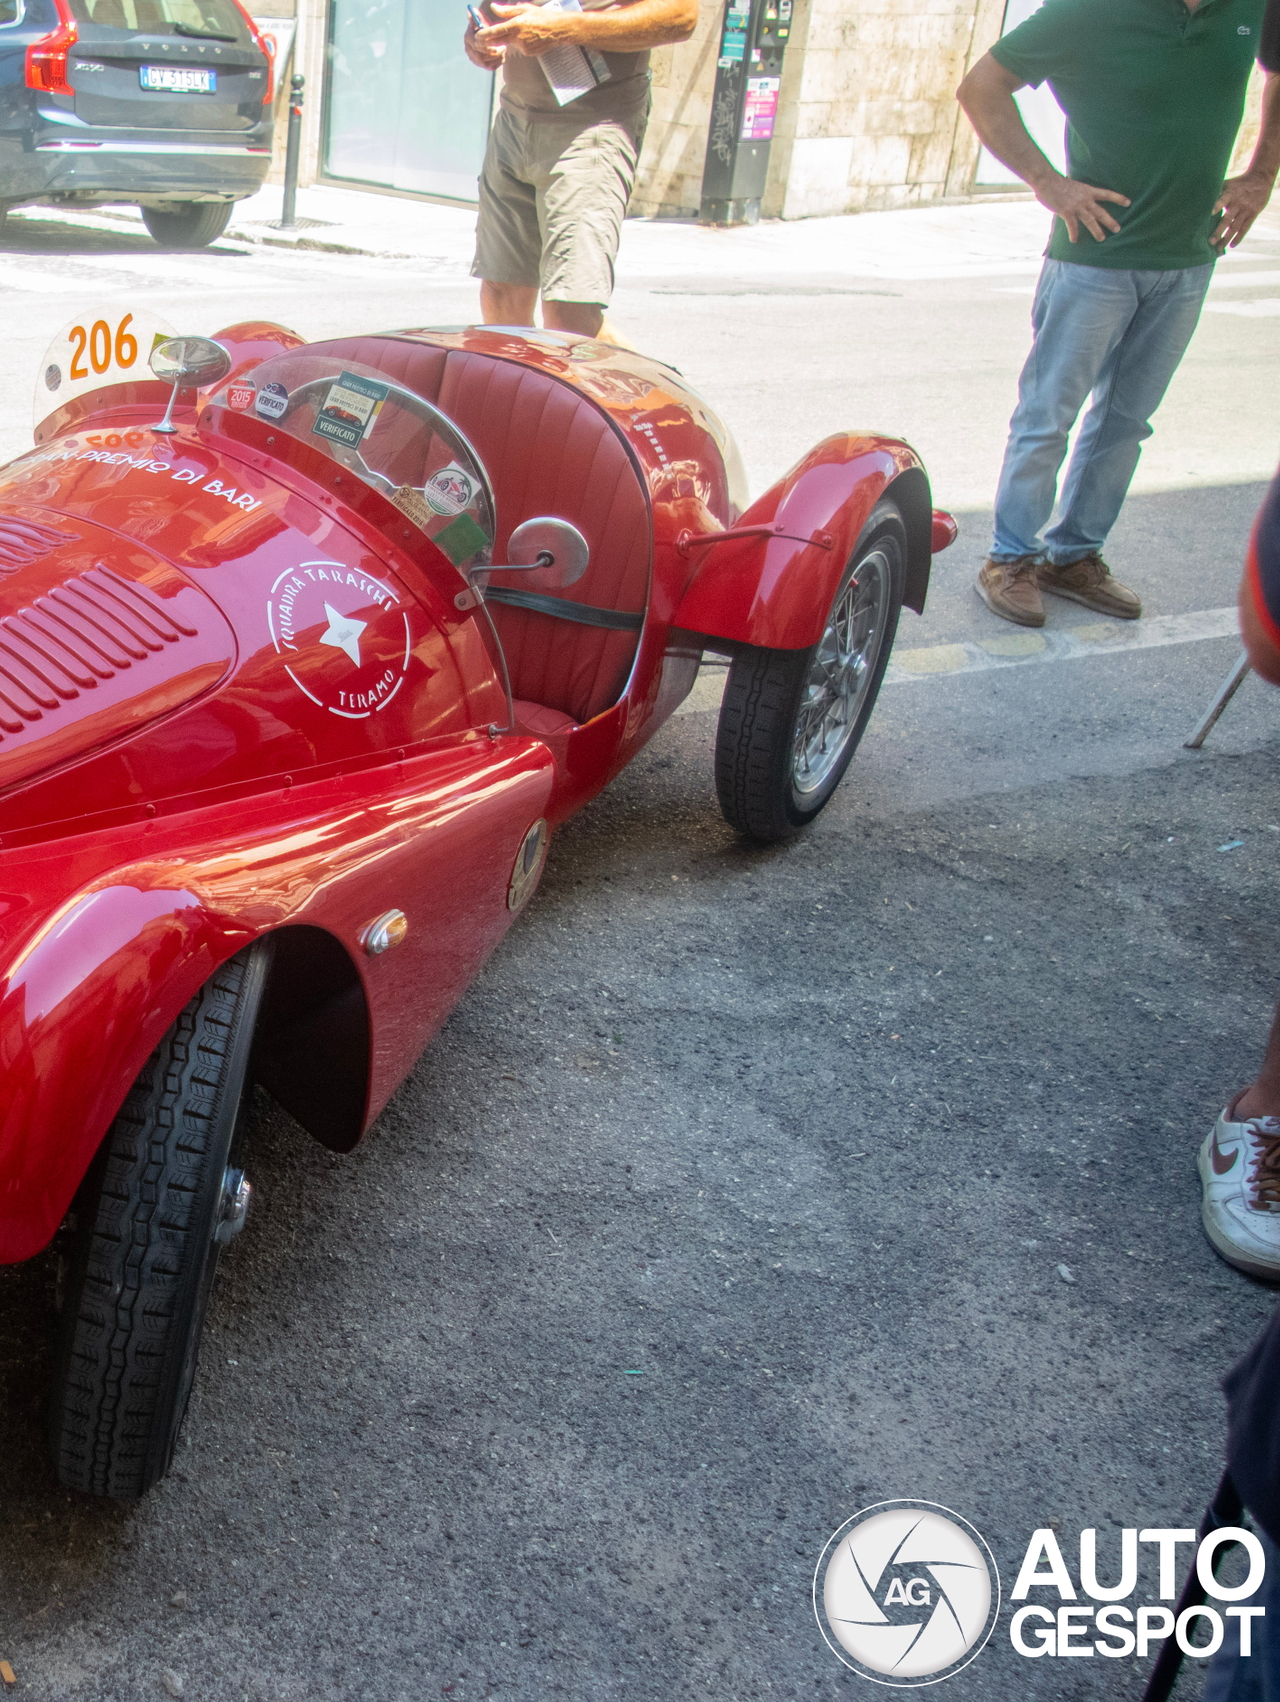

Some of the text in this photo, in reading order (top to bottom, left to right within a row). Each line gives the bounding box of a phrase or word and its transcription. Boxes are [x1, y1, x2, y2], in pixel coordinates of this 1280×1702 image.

[142, 43, 222, 54] VOLVO
[150, 68, 208, 88] GV 315LK
[68, 312, 138, 381] 206
[231, 390, 251, 402] 2015
[259, 395, 285, 412] VERIFICATO
[319, 420, 356, 442] VERIFICATO
[76, 450, 171, 474] PREMIO
[171, 468, 205, 485] DI
[202, 480, 263, 512] BARI
[278, 568, 392, 652] SQUADRA TARASCHI
[338, 669, 395, 709] TERAMO
